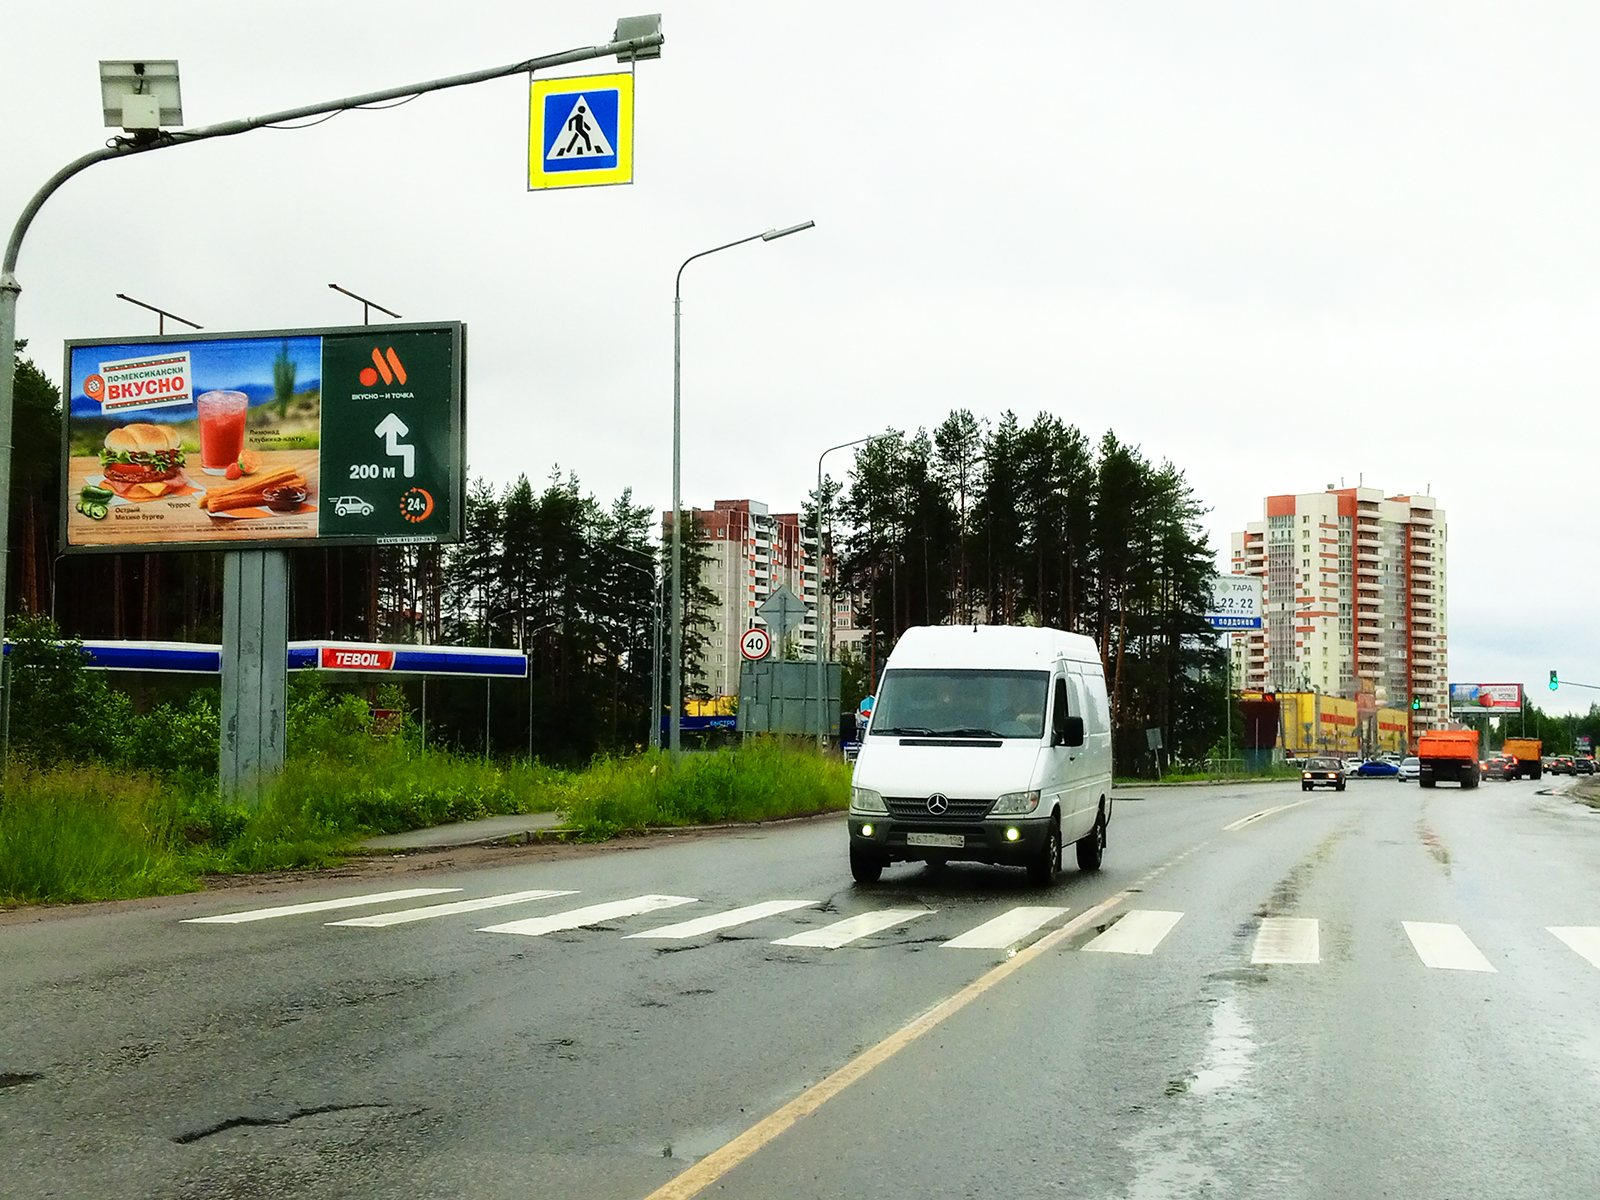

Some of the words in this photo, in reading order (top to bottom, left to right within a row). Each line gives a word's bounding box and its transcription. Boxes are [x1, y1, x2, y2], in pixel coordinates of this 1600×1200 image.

[107, 366, 184, 382] ПО-МЕКСИКАНСКИ
[107, 376, 185, 400] ВКУСНО
[349, 464, 380, 479] 200
[141, 512, 164, 521] бургер
[1231, 584, 1253, 592] ТАРА
[746, 638, 763, 650] 40
[335, 652, 381, 666] TEBOIL
